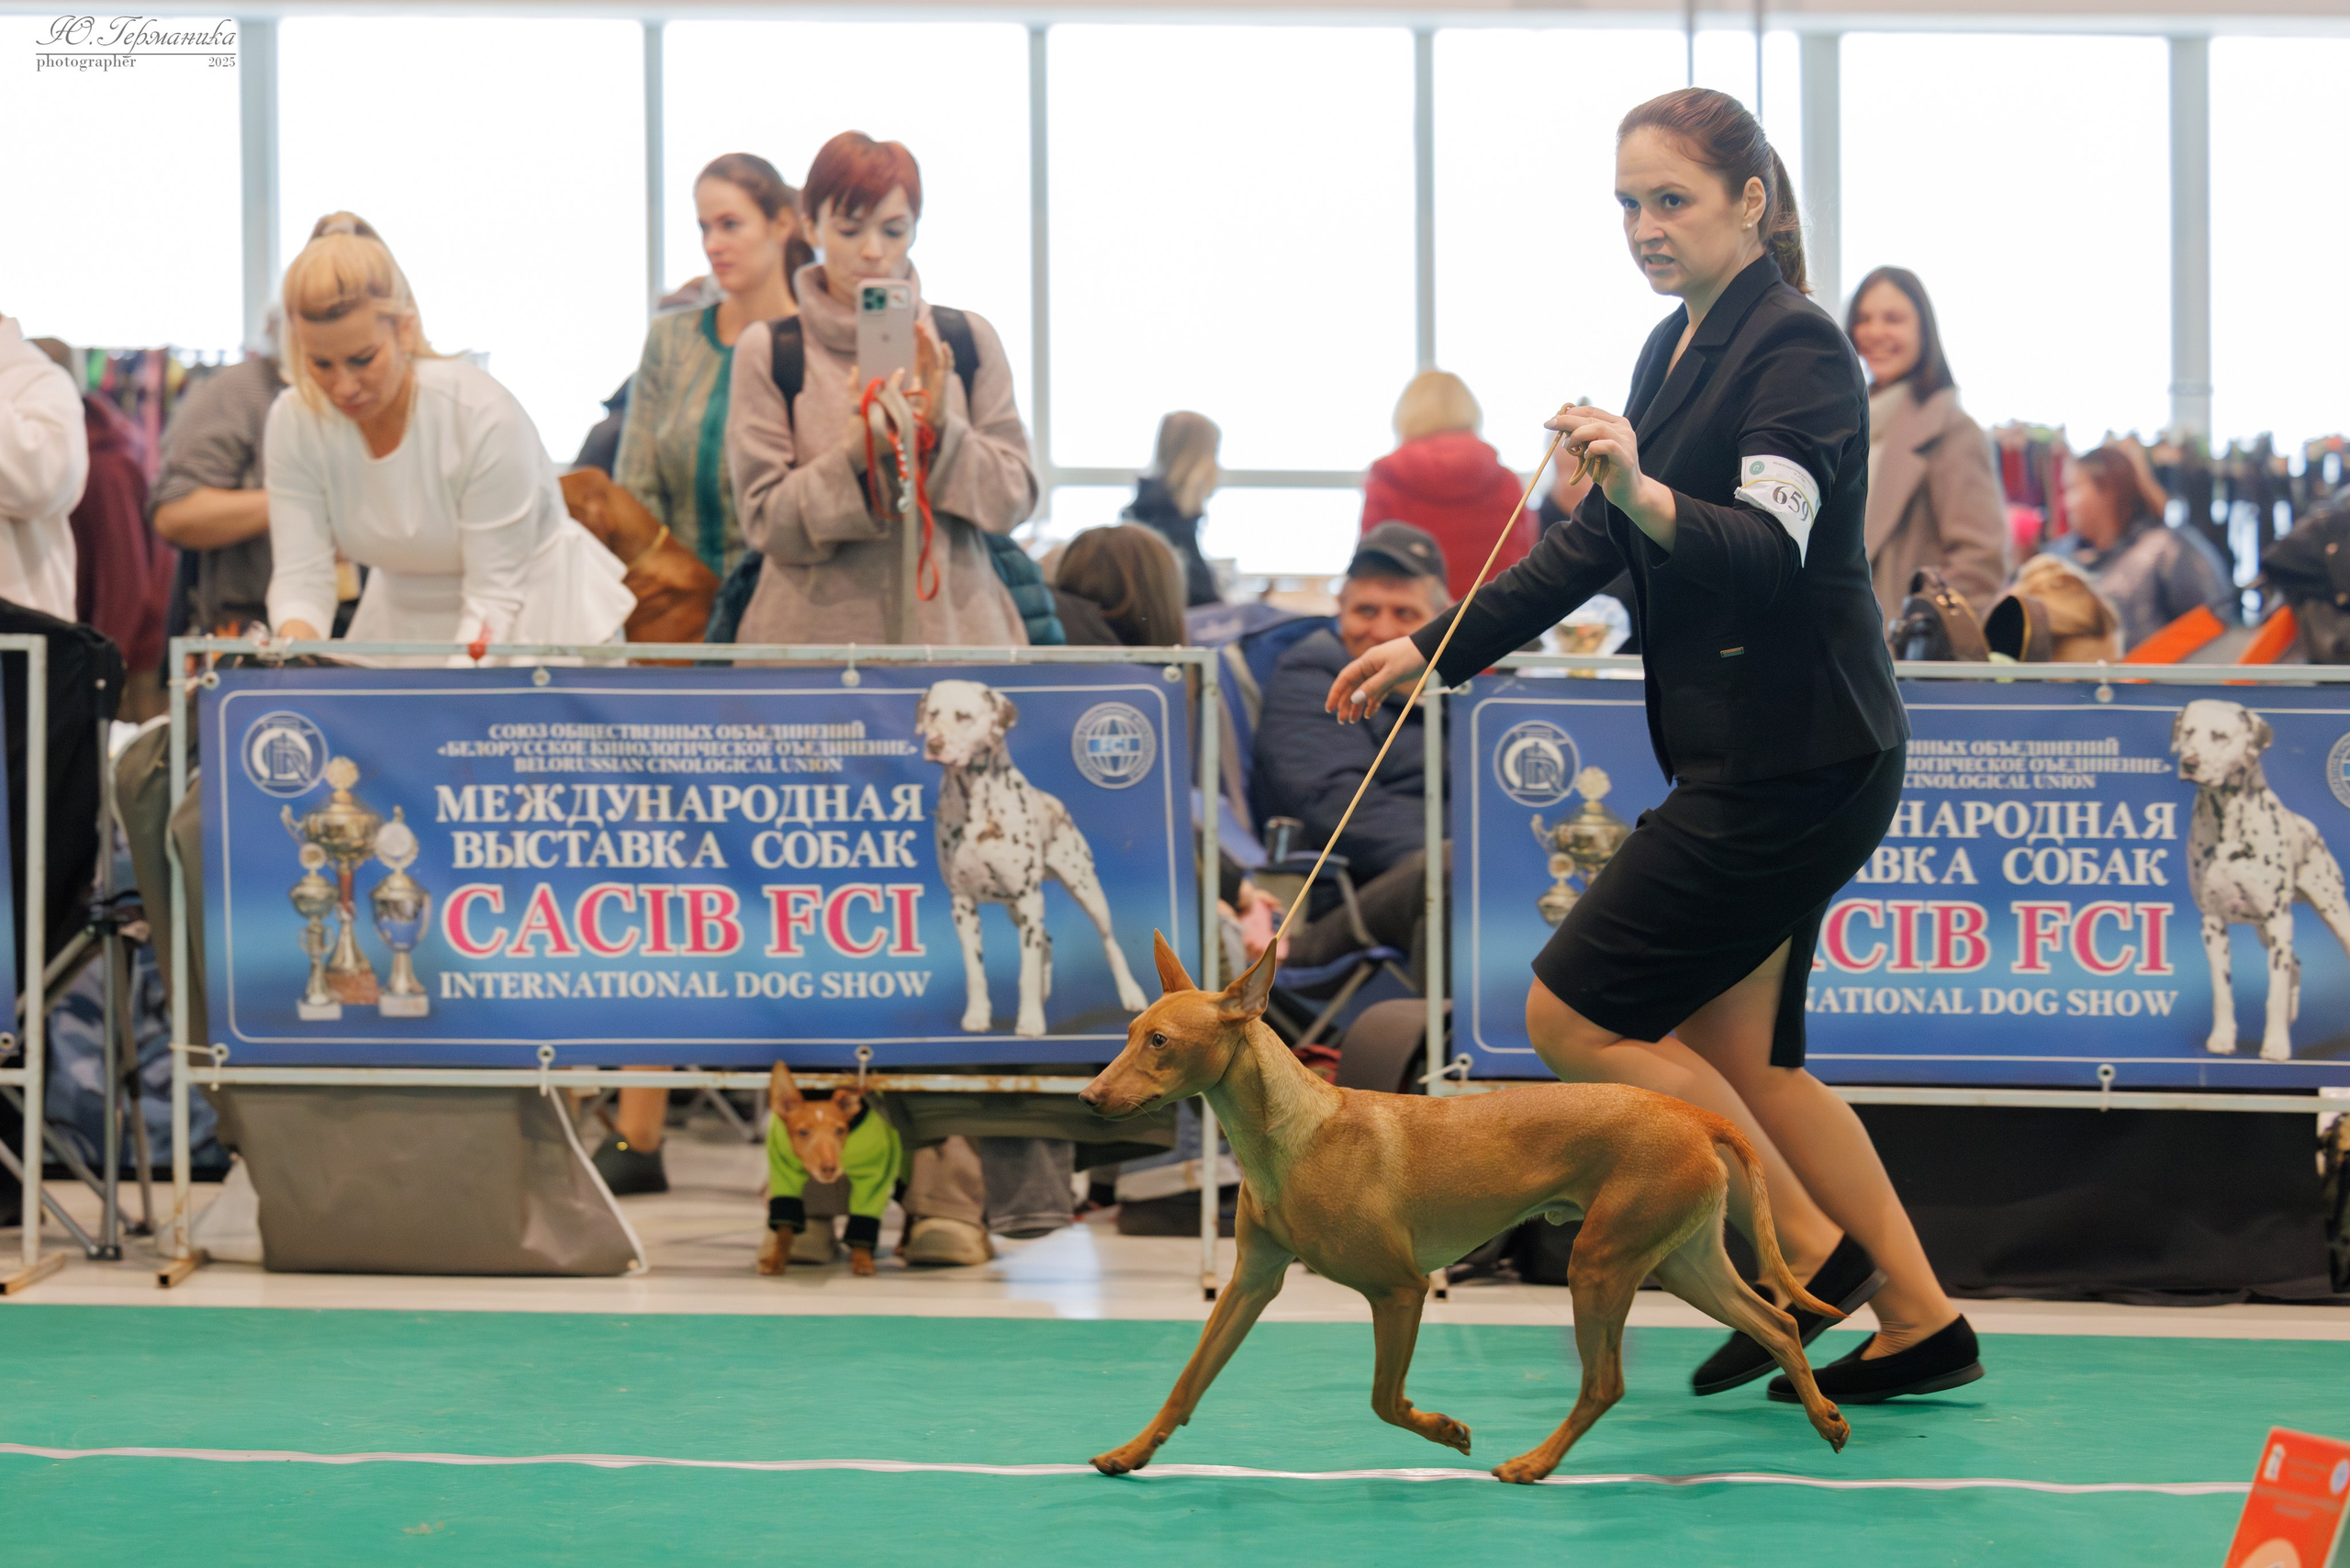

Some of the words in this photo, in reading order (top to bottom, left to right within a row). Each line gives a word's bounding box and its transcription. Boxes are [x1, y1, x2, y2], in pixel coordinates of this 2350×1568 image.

[1773, 486, 1809, 521] 659
[488, 723, 548, 740] СОЮЗ
[514, 757, 644, 773] BELORUSSIAN
[646, 757, 778, 773] CINOLOGICAL
[780, 757, 844, 773] UNION
[2032, 774, 2097, 790] UNION
[434, 783, 925, 829] МЕЖДУНАРОДНАЯ
[1886, 800, 2178, 846] НАРОДНАЯ
[451, 829, 730, 869] ВЫСТАВКА
[751, 829, 918, 869] СОБАК
[2002, 846, 2169, 887] СОБАК
[442, 881, 744, 959] CACIB
[762, 882, 927, 958] FCI
[1811, 898, 1991, 974] CIB
[2009, 900, 2175, 976] FCI
[440, 971, 730, 1000] INTERNATIONAL
[734, 970, 815, 999] DOG
[821, 970, 932, 999] SHOW
[1979, 988, 2060, 1016] DOG
[2066, 989, 2179, 1018] SHOW
